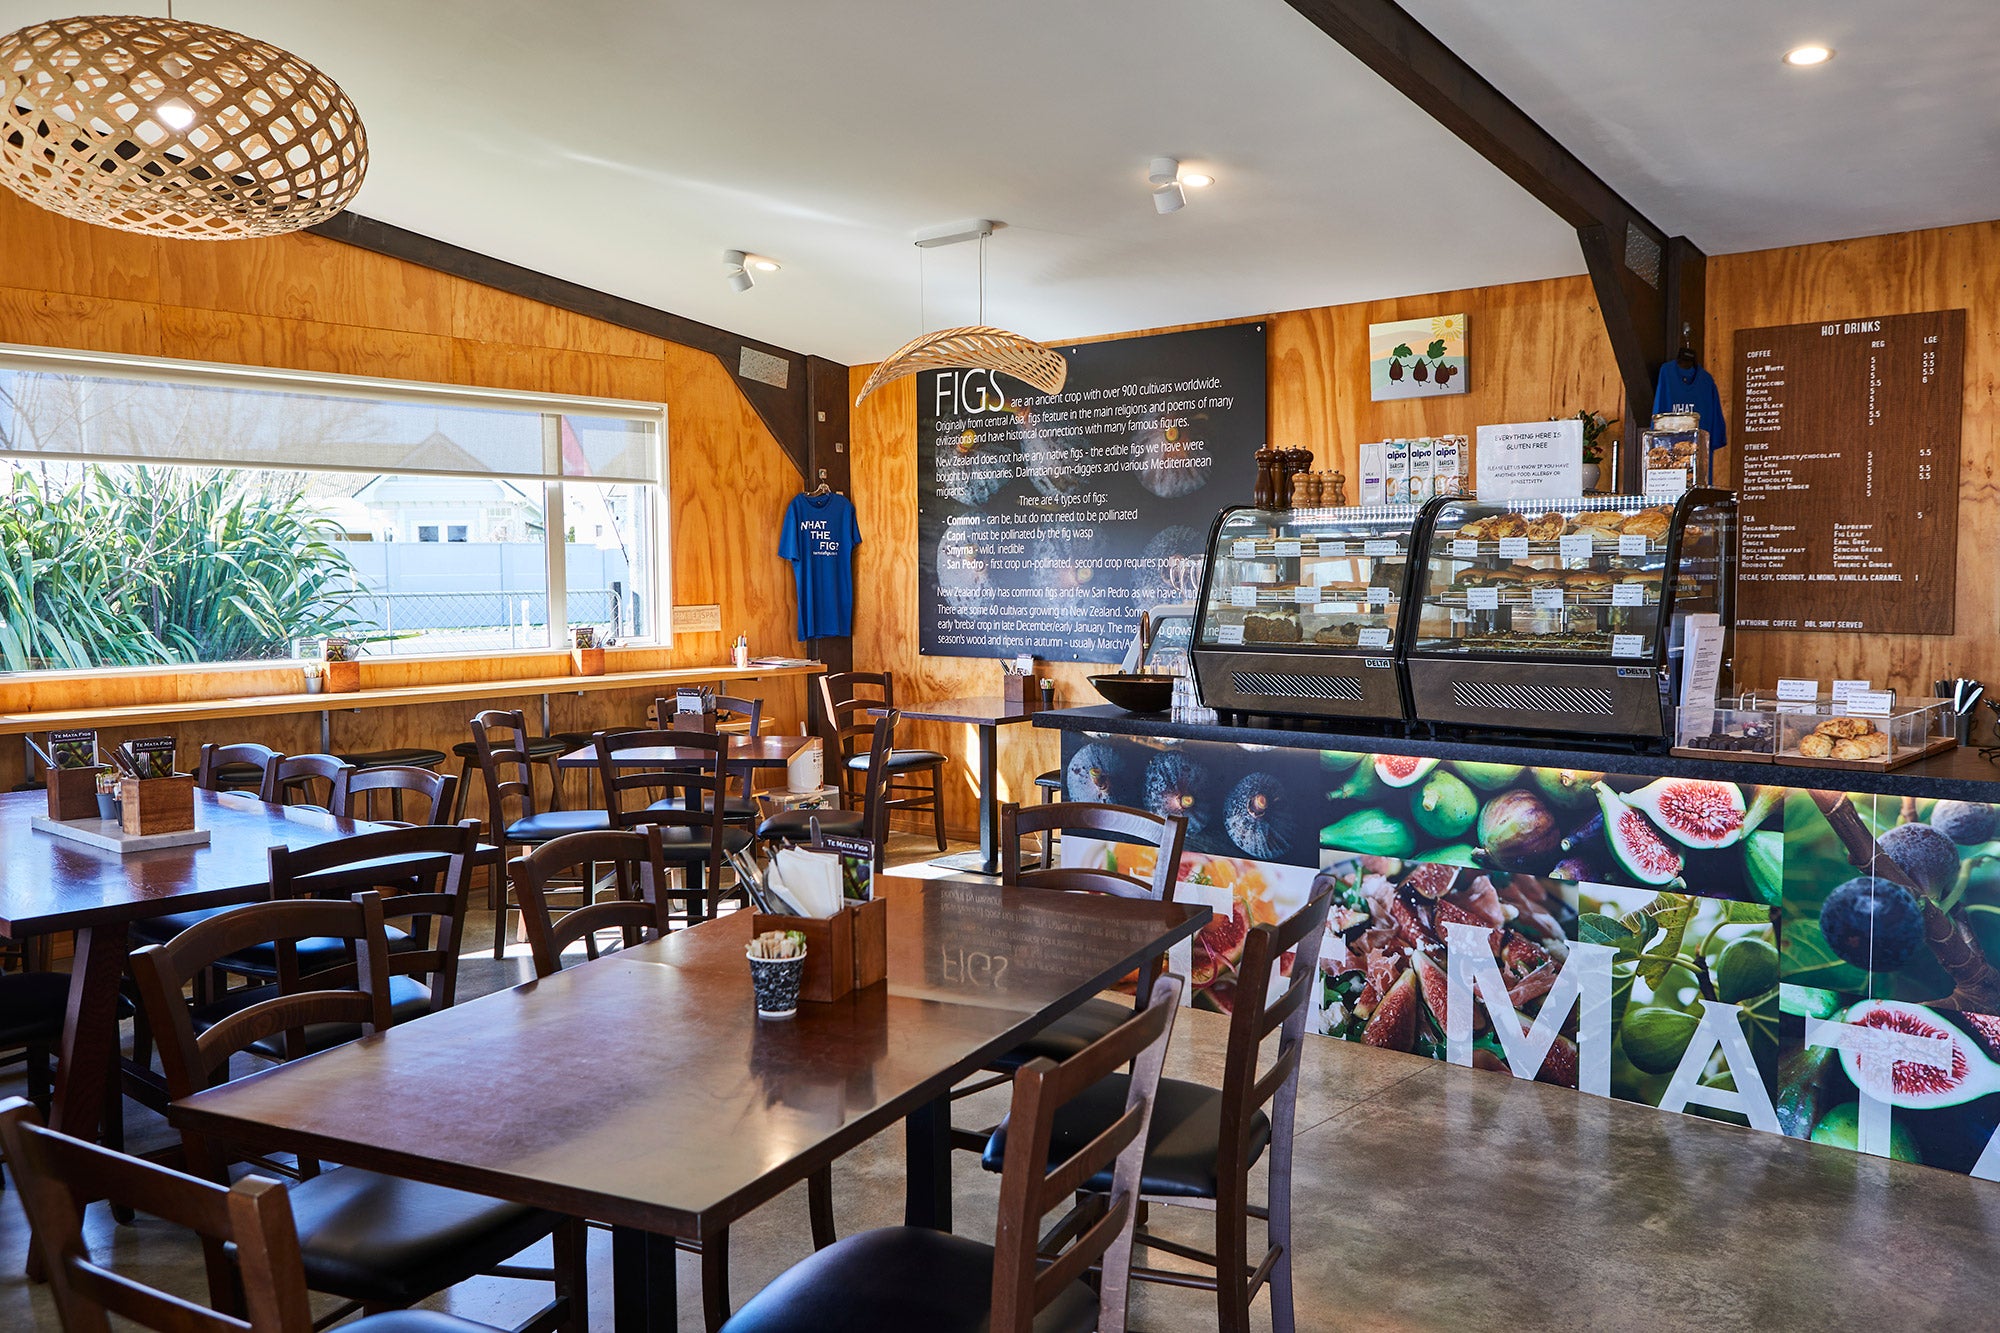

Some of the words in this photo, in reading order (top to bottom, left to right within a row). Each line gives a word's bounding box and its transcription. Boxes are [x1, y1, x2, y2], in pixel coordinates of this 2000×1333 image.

[1821, 324, 1841, 337] HOT
[1844, 320, 1881, 334] DRINKS
[1747, 350, 1772, 359] COFFEE
[1871, 340, 1885, 348] REG
[1924, 335, 1938, 344] LGE
[1923, 351, 1935, 360] 5.5
[1923, 360, 1935, 368] 5.5
[1922, 368, 1935, 376] 5.5
[935, 368, 1005, 416] FIGS
[1010, 399, 1022, 408] are
[1024, 398, 1034, 407] an
[1035, 394, 1063, 406] ancient
[1064, 393, 1081, 405] crop
[1083, 389, 1101, 401] with
[1103, 389, 1120, 399] over
[1122, 385, 1137, 397] 900
[1139, 384, 1173, 396] cultivars
[1174, 377, 1222, 392] worldwide.
[1672, 403, 1695, 413] WHAT
[935, 419, 966, 434] Originally
[967, 418, 984, 429] from
[984, 415, 1009, 427] central
[1009, 415, 1024, 425] Asia,
[1028, 413, 1041, 426] figs
[1043, 412, 1069, 422] feature
[1069, 410, 1078, 420] in
[1079, 408, 1092, 419] the
[1093, 407, 1113, 418] main
[1115, 404, 1147, 418] religions
[1149, 401, 1165, 413] and
[1167, 401, 1196, 415] poems
[1197, 397, 1207, 409] of
[1208, 397, 1234, 410] many
[973, 433, 987, 444] and
[988, 432, 1005, 443] have
[1006, 429, 1037, 441] historical
[1038, 426, 1083, 439] connections
[1084, 423, 1103, 435] with
[1104, 423, 1127, 435] many
[1128, 421, 1158, 432] famous
[1160, 418, 1190, 432] figures.
[1495, 433, 1534, 441] EVERYTHING
[1744, 443, 1769, 451] OTHERS
[1387, 451, 1407, 461] alpro
[1411, 449, 1432, 459] alpro
[1436, 448, 1456, 458] alpro
[936, 471, 961, 485] bought
[962, 471, 970, 484] by
[1054, 464, 1102, 479] gum-diggers
[1103, 461, 1119, 473] and
[1120, 461, 1149, 472] various
[1151, 458, 1212, 470] Mediterranean
[1919, 464, 1931, 472] 5.5
[1919, 472, 1931, 480] 5.5
[1019, 496, 1040, 507] There
[1040, 497, 1053, 506] are
[1054, 495, 1059, 505] 4
[1060, 495, 1081, 508] types
[1082, 493, 1091, 504] of
[1092, 493, 1108, 506] figs:
[947, 516, 980, 526] Common
[987, 516, 1000, 525] can
[1001, 514, 1012, 525] be,
[1014, 513, 1027, 524] but
[1028, 513, 1039, 523] do
[1040, 513, 1054, 523] not
[1055, 511, 1075, 522] need
[1076, 512, 1086, 522] to
[1086, 511, 1097, 521] be
[1099, 509, 1138, 524] pollinated
[801, 521, 827, 530] WHAT
[810, 531, 830, 540] THE
[820, 541, 839, 550] FIG?
[938, 605, 956, 615] There
[957, 607, 968, 615] are
[969, 607, 988, 615] some
[989, 606, 999, 616] 60
[1000, 605, 1028, 616] cultivars
[1029, 606, 1060, 619] growing
[1070, 606, 1089, 617] New
[1089, 606, 1123, 617] Zealand.
[1837, 621, 1864, 629] SERVED
[1166, 868, 1346, 1041] T
[1442, 921, 2000, 1182] MAT
